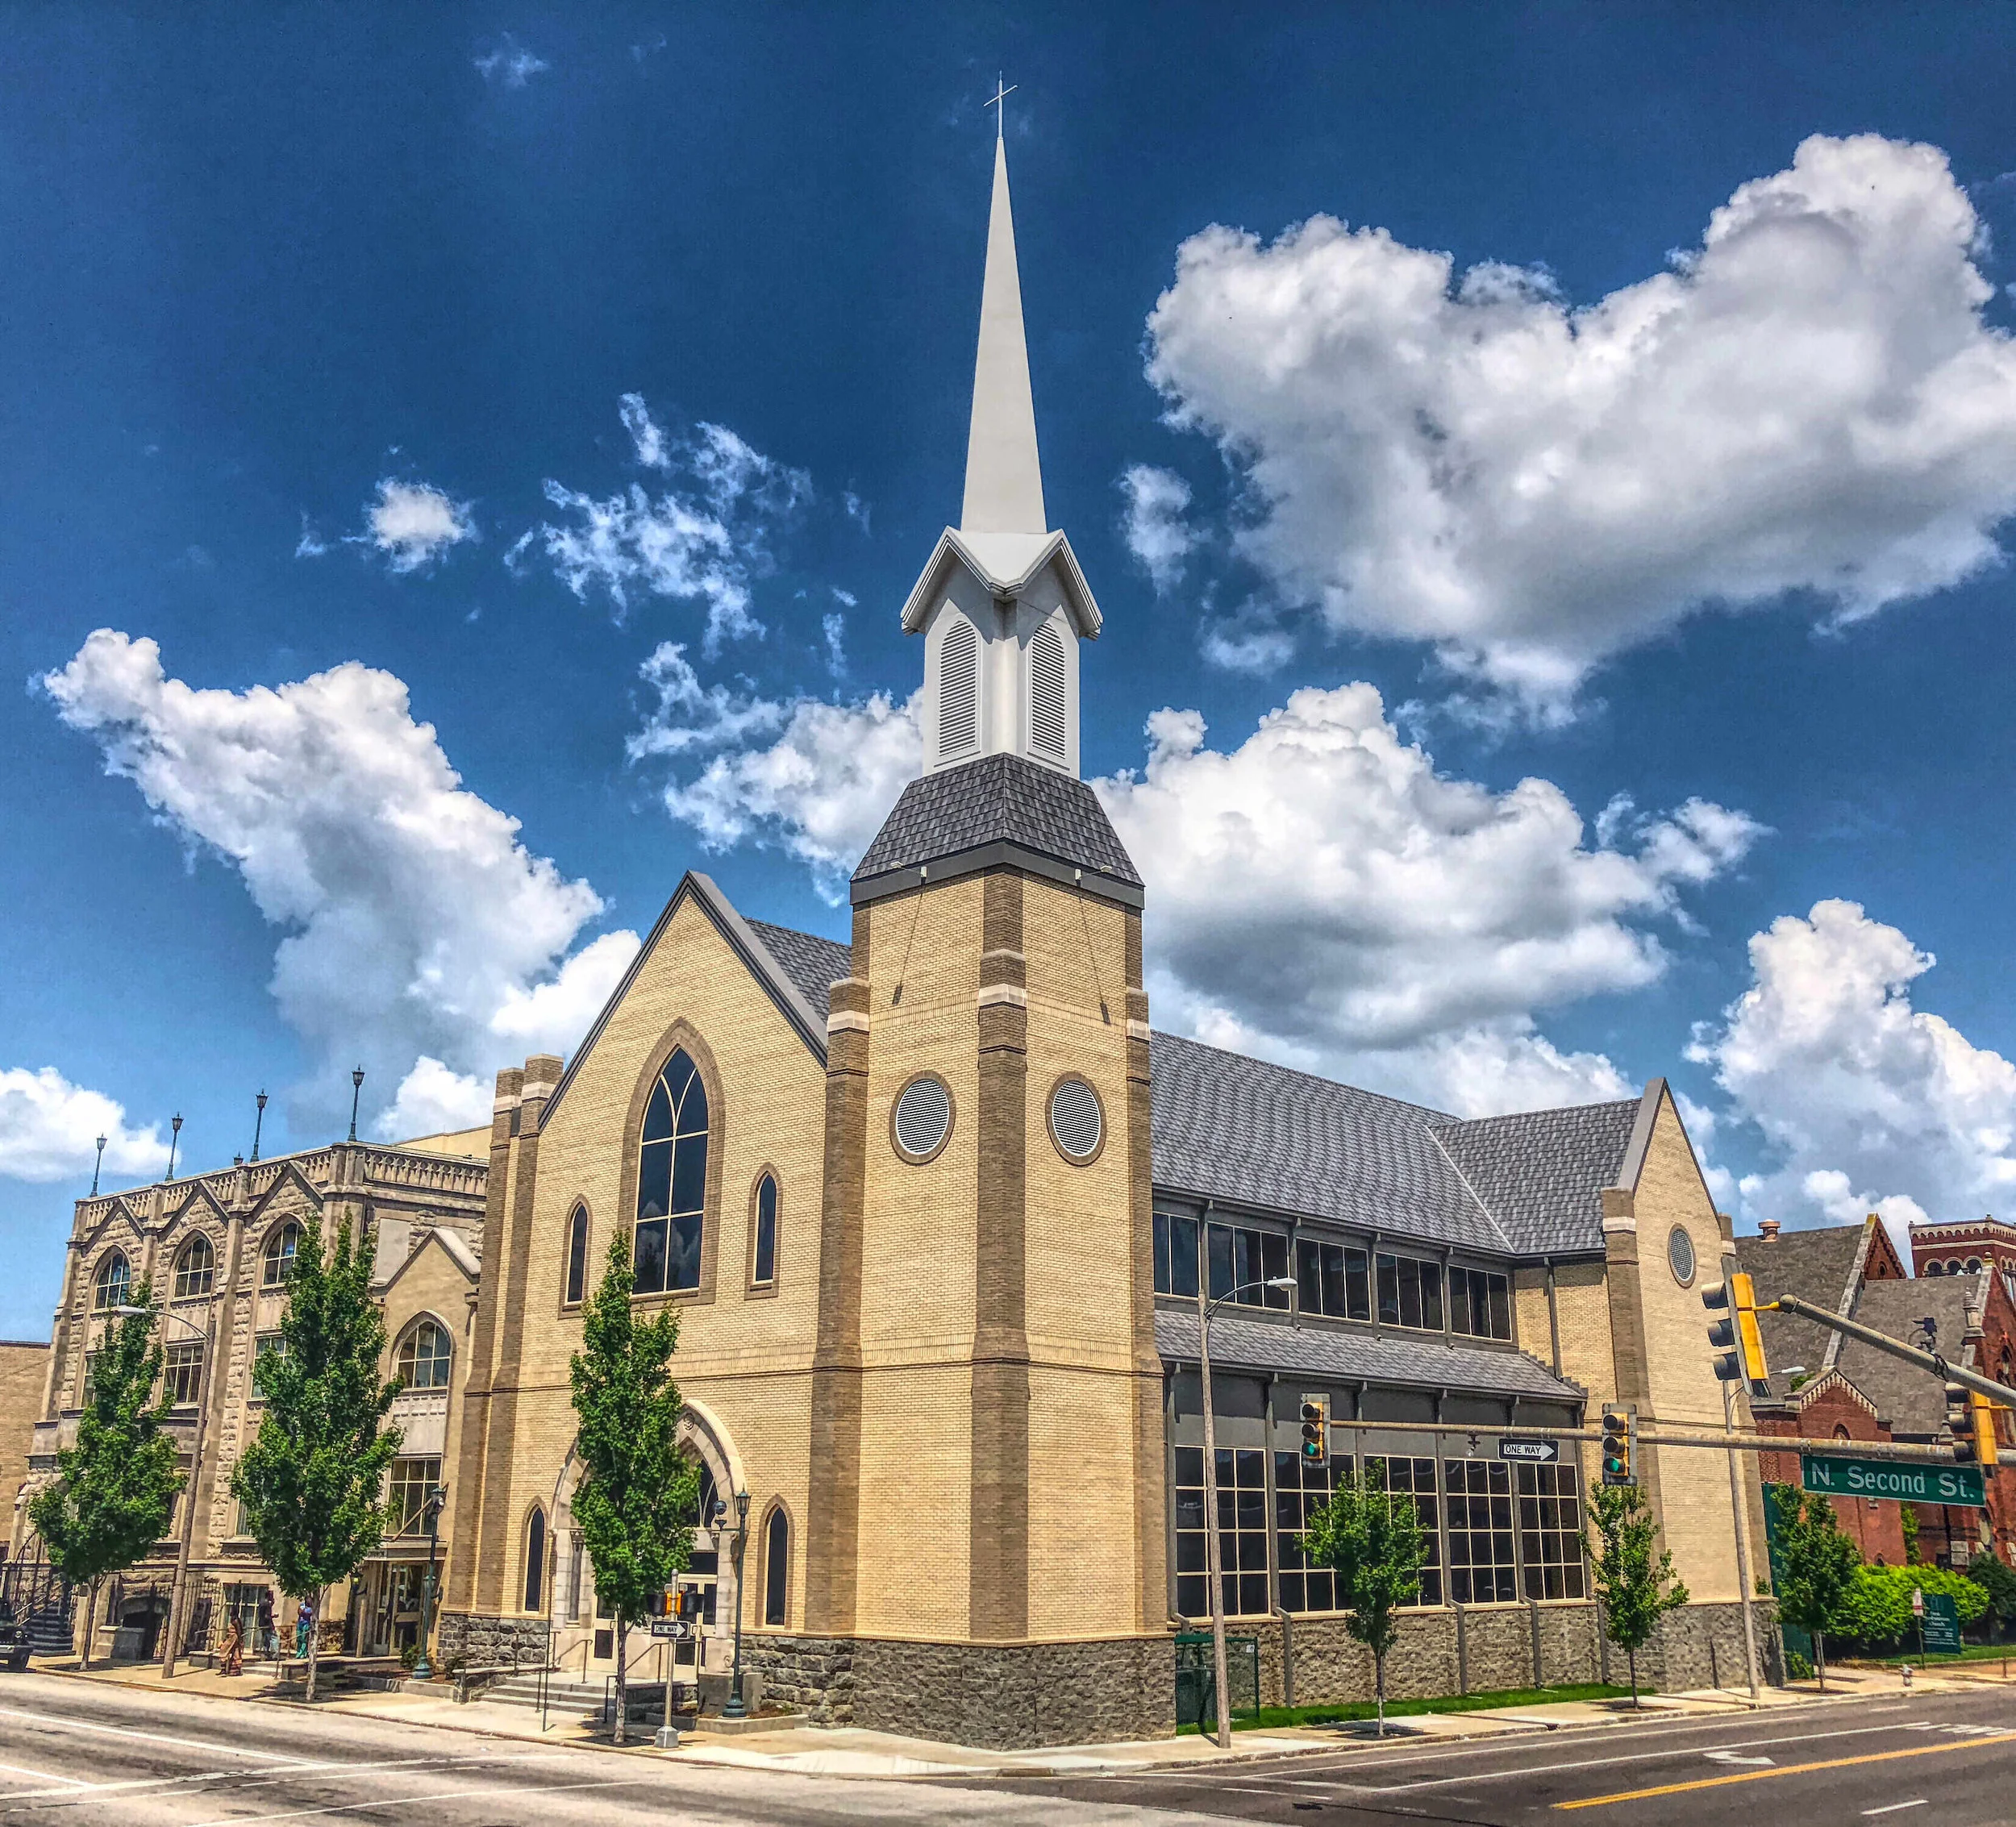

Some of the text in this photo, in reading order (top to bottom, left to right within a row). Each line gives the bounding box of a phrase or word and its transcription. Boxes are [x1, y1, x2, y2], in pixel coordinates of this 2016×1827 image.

[1506, 1445, 1541, 1455] ONE WAY
[1811, 1463, 1975, 1499] N. Second St.
